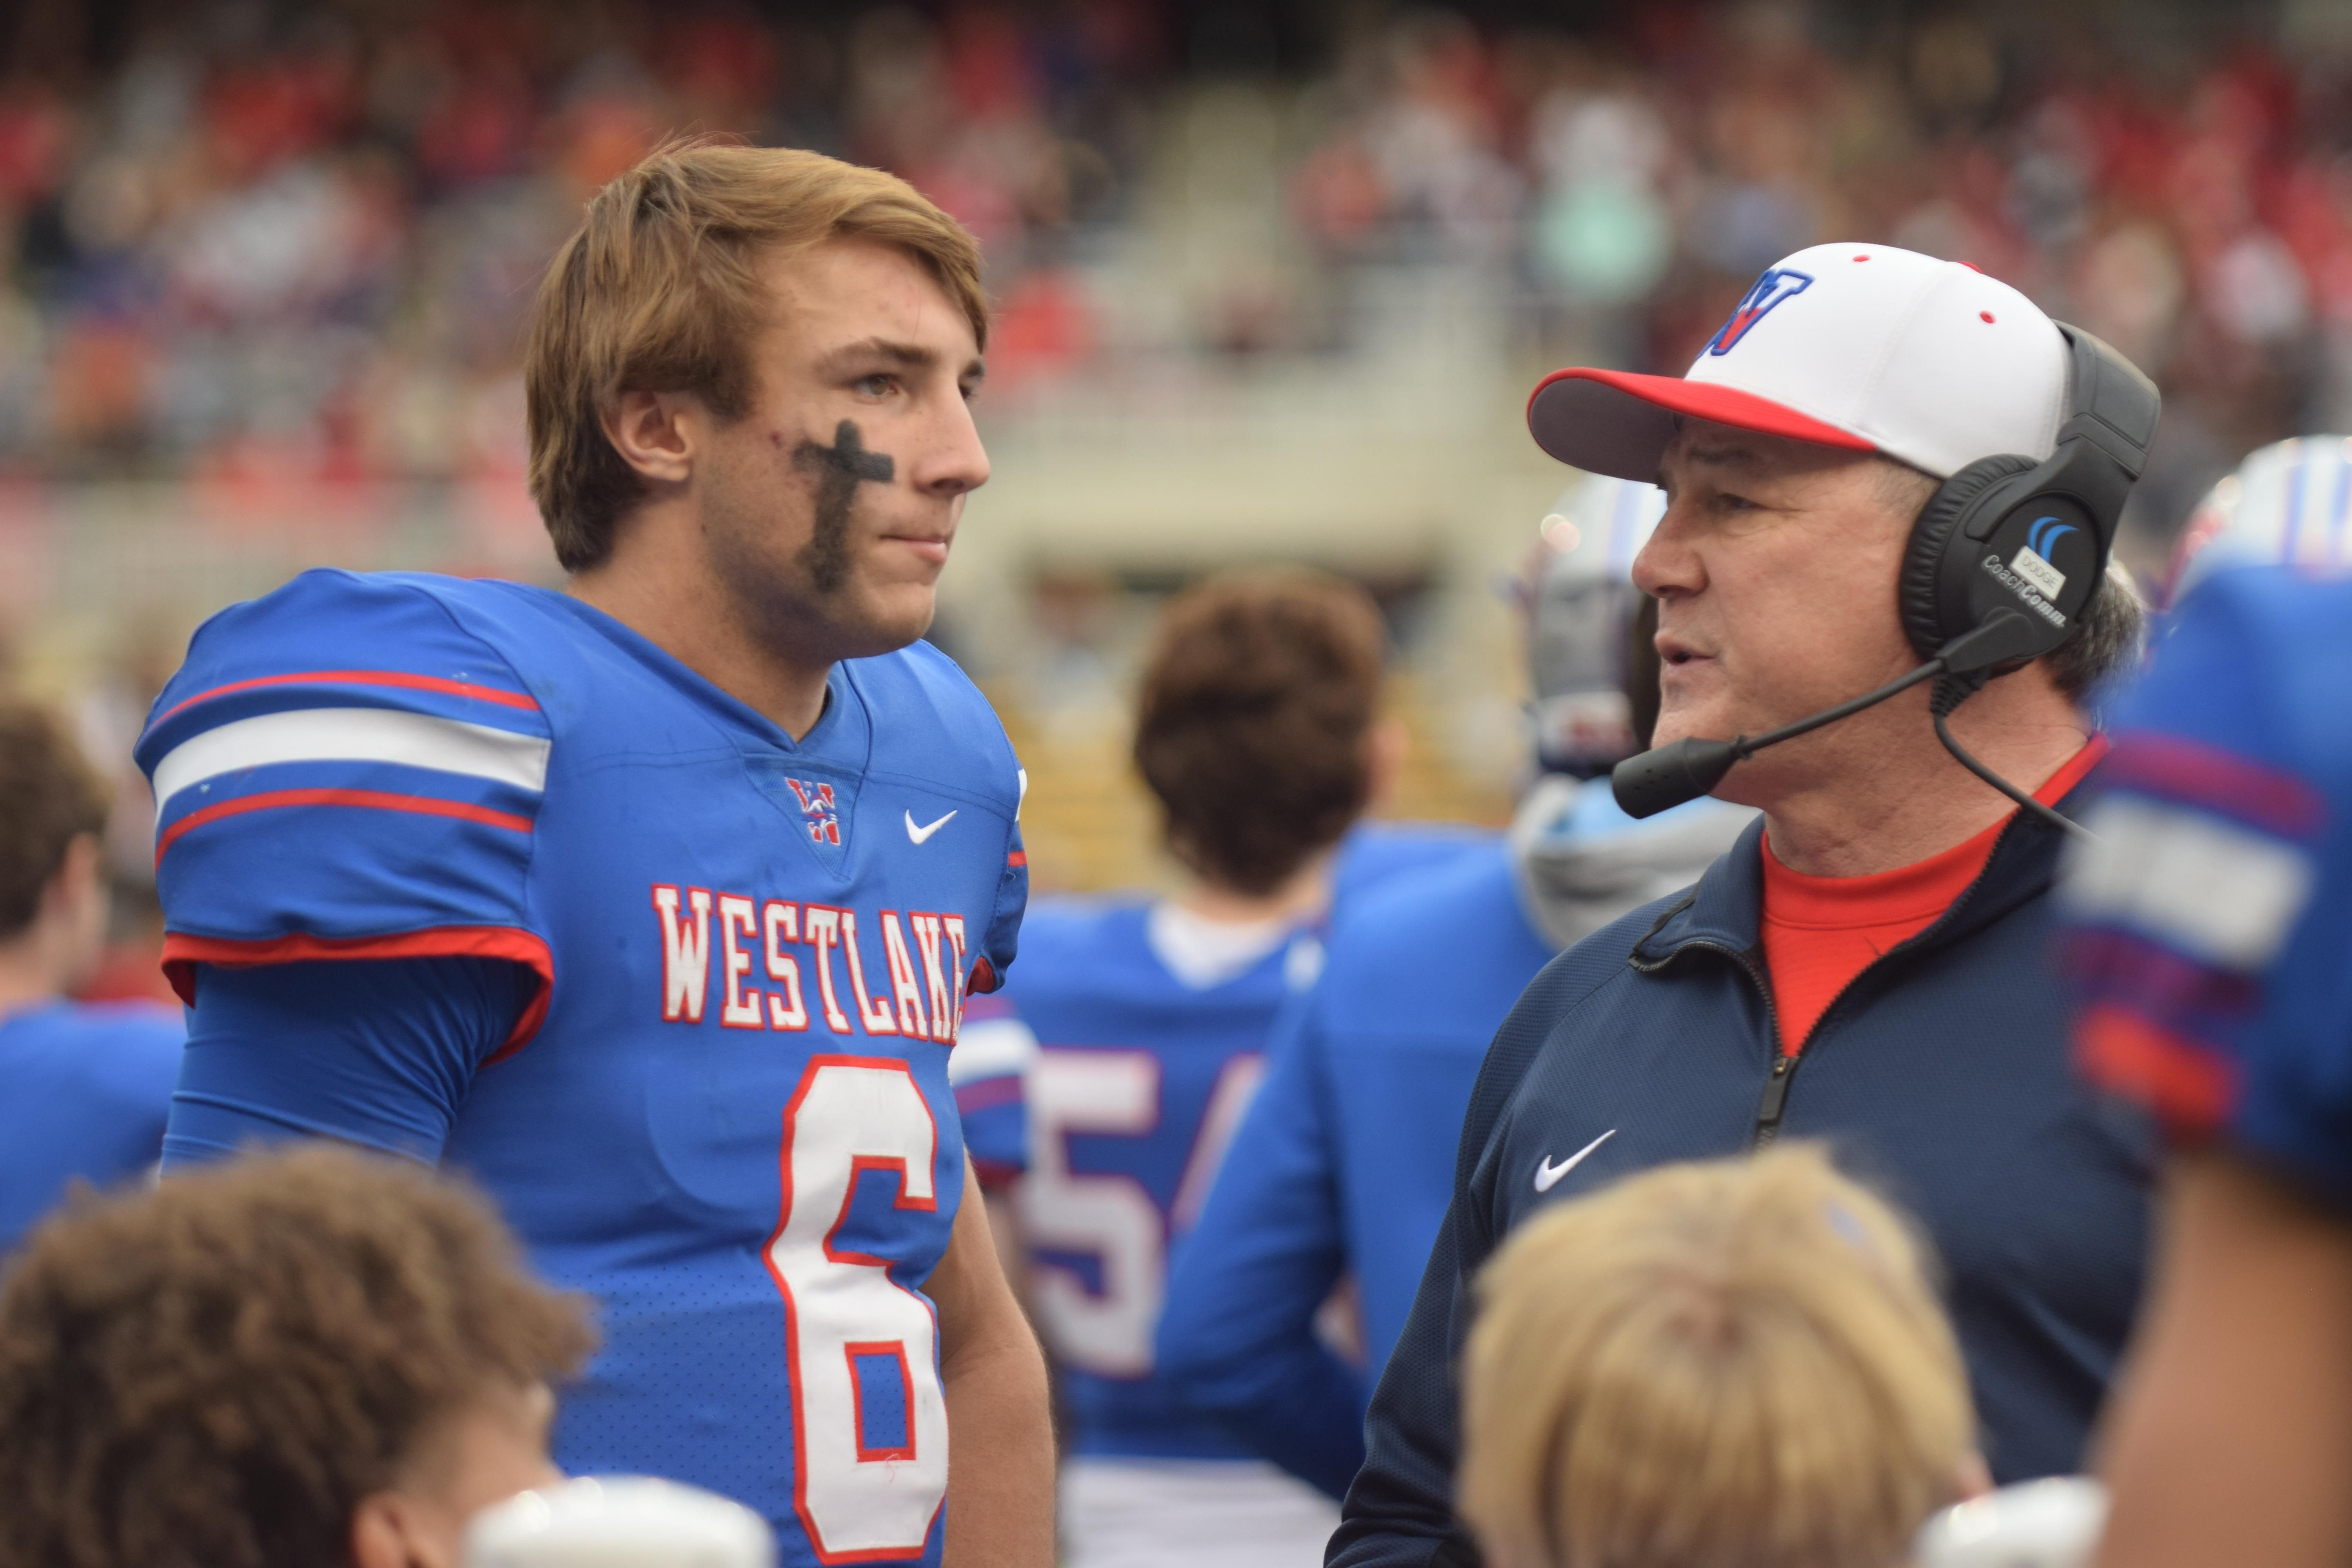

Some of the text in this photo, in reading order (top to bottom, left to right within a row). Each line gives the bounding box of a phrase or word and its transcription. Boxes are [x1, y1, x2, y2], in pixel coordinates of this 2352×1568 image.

[2022, 555, 2059, 588] DODGE
[651, 883, 965, 1046] WESTLAKE
[762, 1053, 949, 1566] 6
